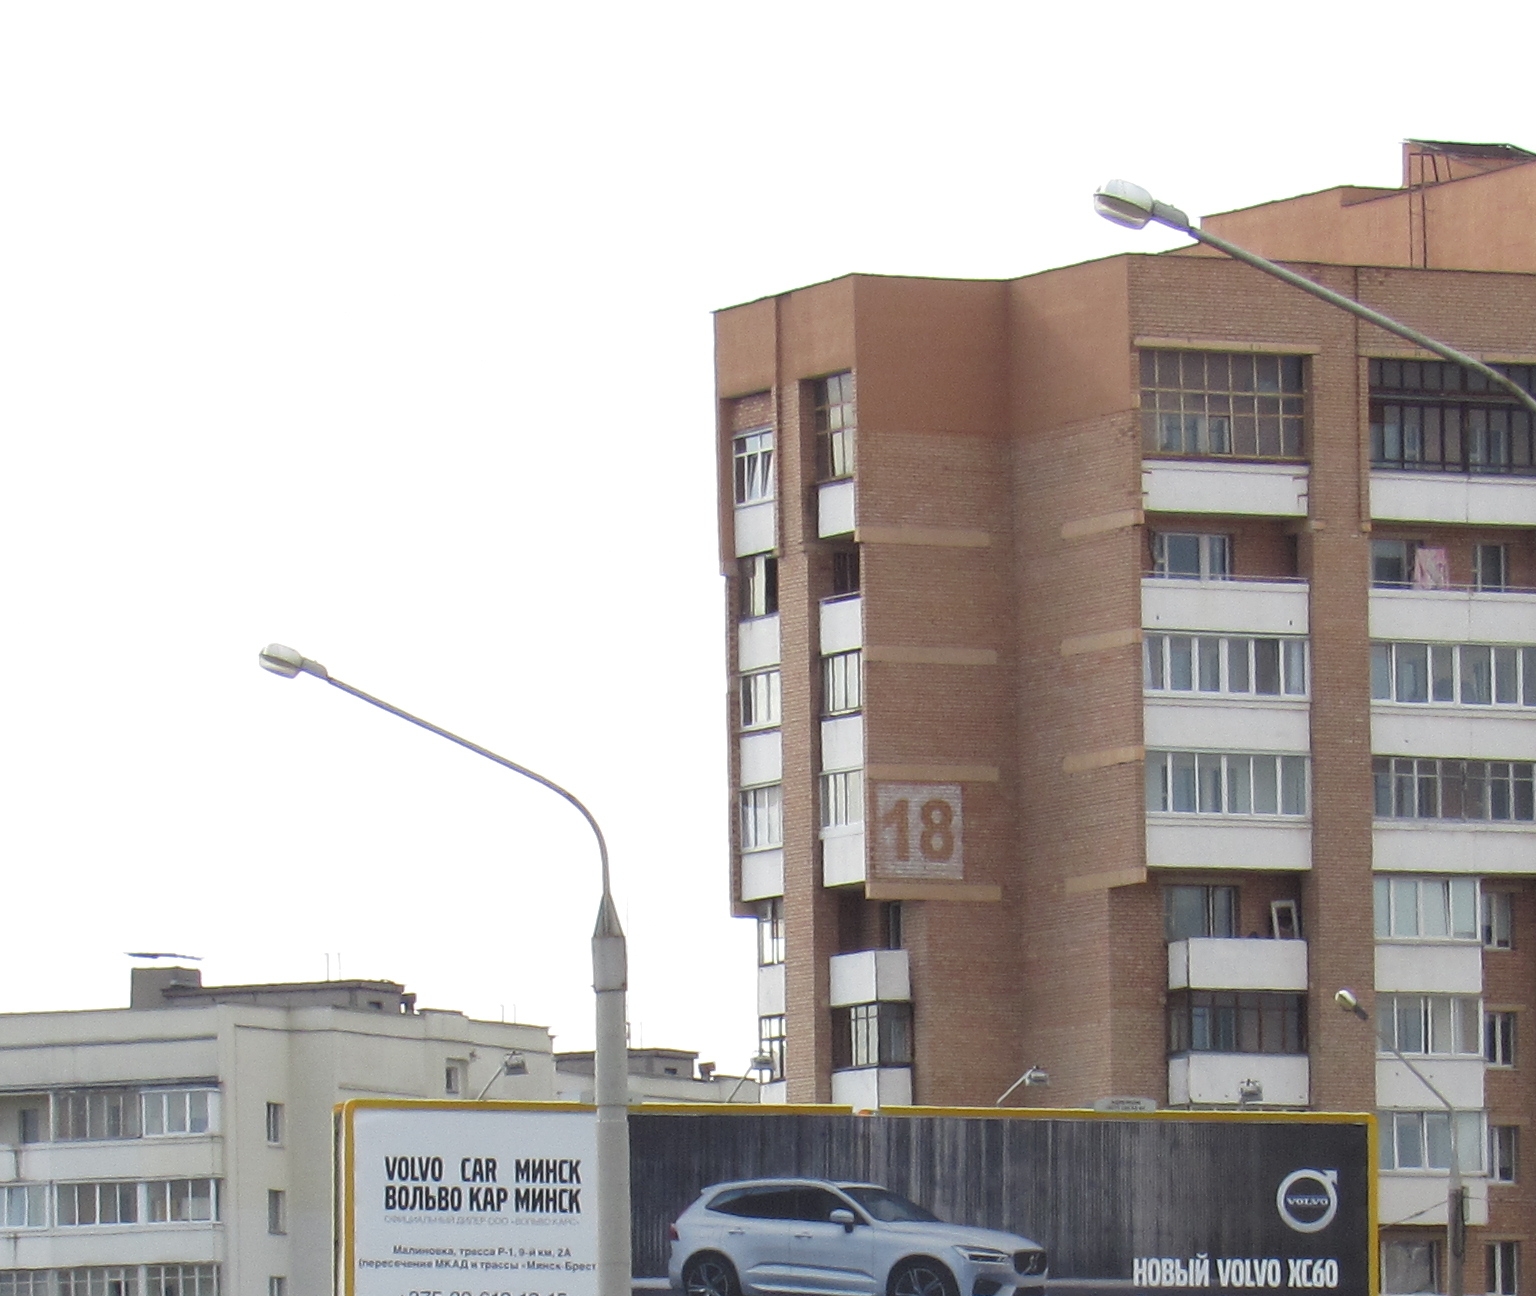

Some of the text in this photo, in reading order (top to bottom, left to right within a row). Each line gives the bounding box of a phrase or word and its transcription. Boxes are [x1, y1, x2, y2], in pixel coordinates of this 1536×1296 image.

[884, 798, 955, 861] 18
[384, 1156, 582, 1184] VOLVO CAR МИНСК
[384, 1186, 582, 1213] ВОЛЬВО КАР МИНСК
[1286, 1197, 1329, 1206] VOLVO
[392, 1245, 456, 1257] Малиновка,
[459, 1248, 496, 1258] трасса
[434, 1259, 469, 1271] МКАД
[480, 1261, 519, 1271] трассы
[1133, 1253, 1339, 1288] НОВЫЙ VOLVO XC60
